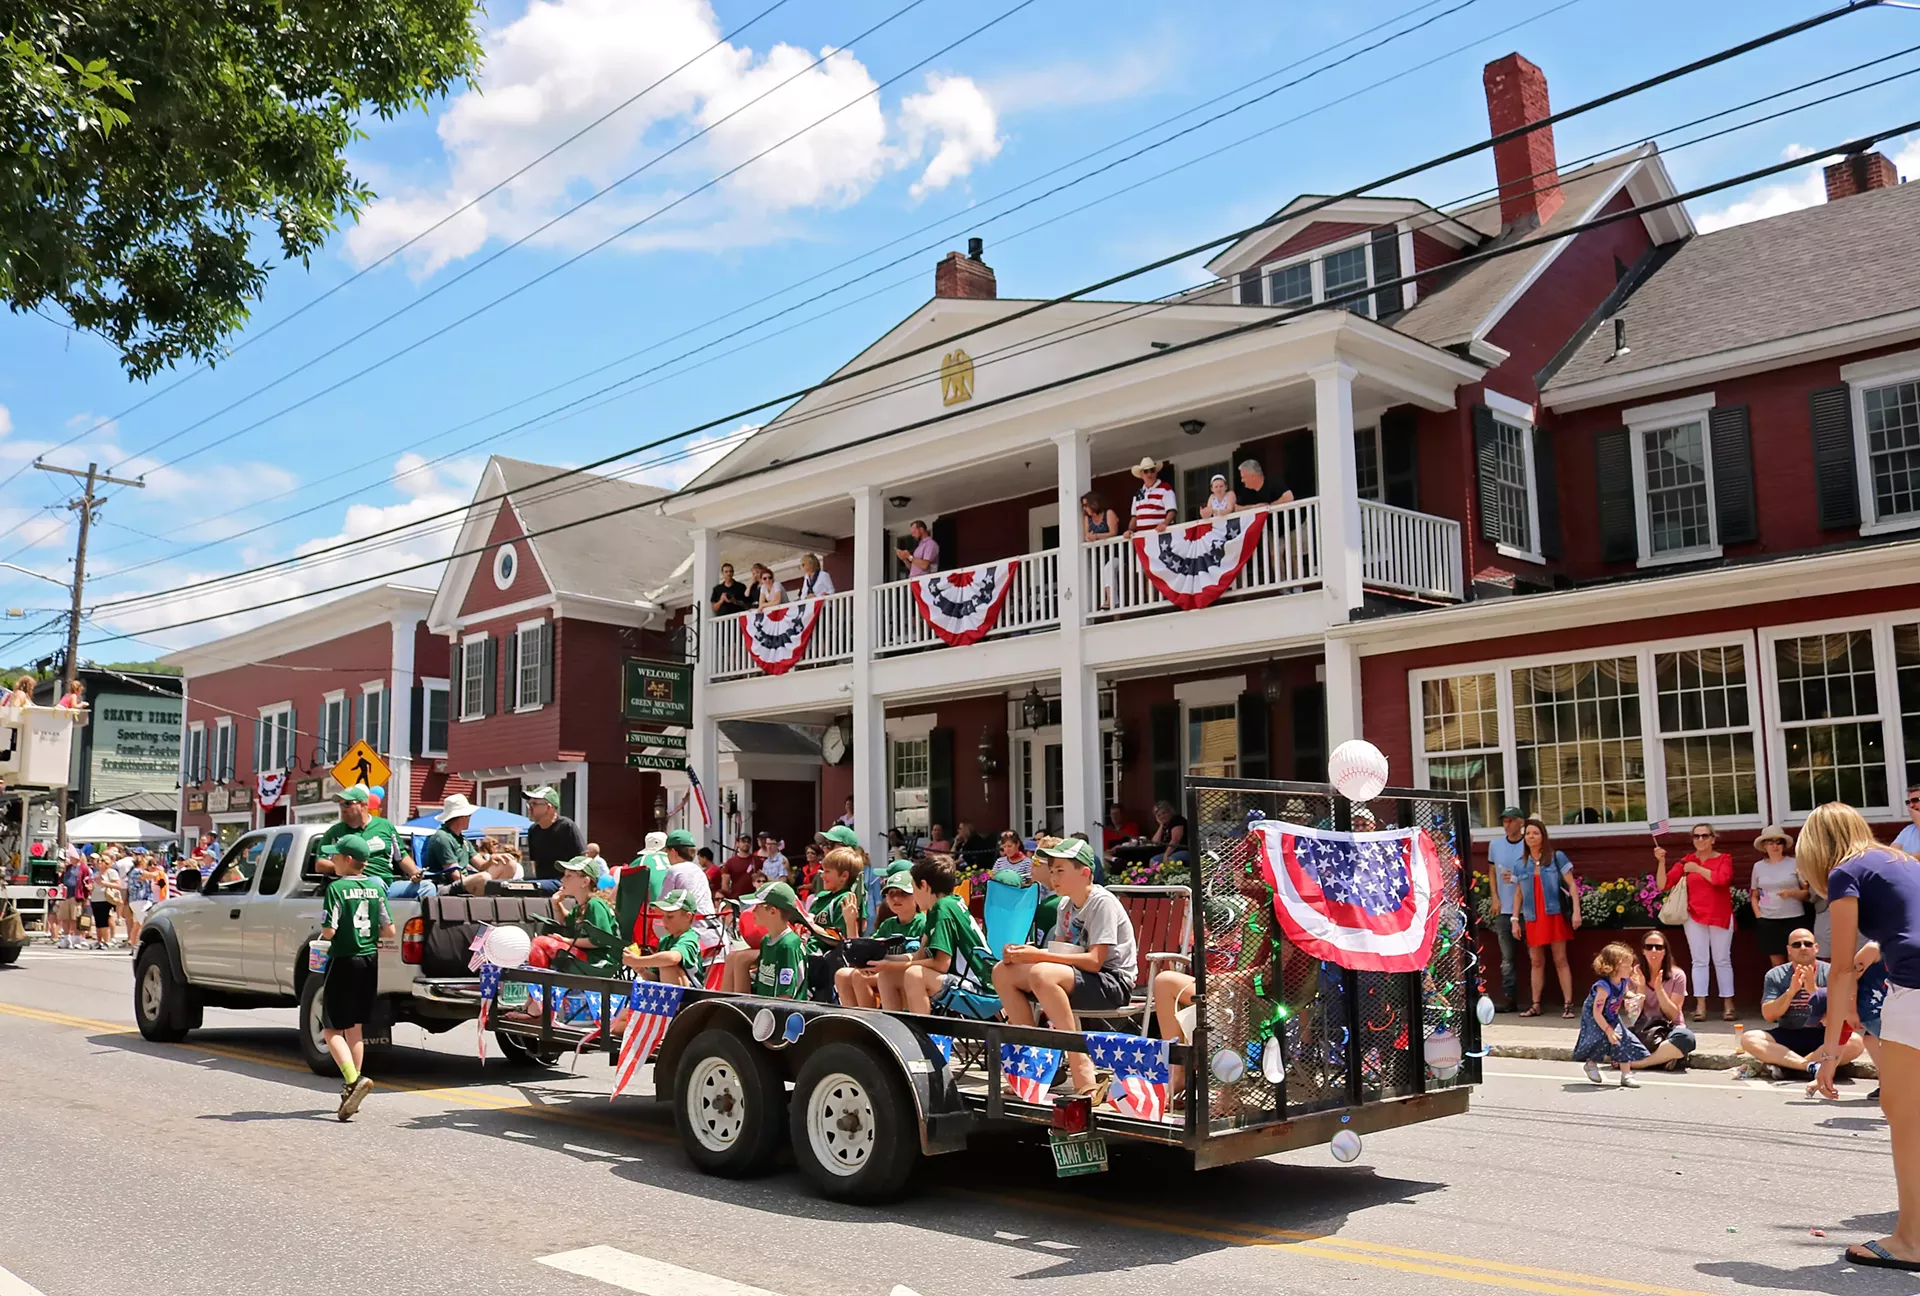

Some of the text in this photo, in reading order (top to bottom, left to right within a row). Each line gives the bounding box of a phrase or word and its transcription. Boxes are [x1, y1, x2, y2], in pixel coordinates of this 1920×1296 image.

[637, 667, 680, 680] WELCOME
[631, 697, 685, 710] GREEN MOUNTAIN
[103, 708, 143, 722] SHAW'S
[652, 707, 664, 715] INN
[117, 729, 181, 743] Sporting Goo
[630, 734, 684, 747] SWIMMING POOL
[637, 756, 677, 768] VACANCY
[353, 899, 371, 938] 4
[1084, 1140, 1105, 1162] 841
